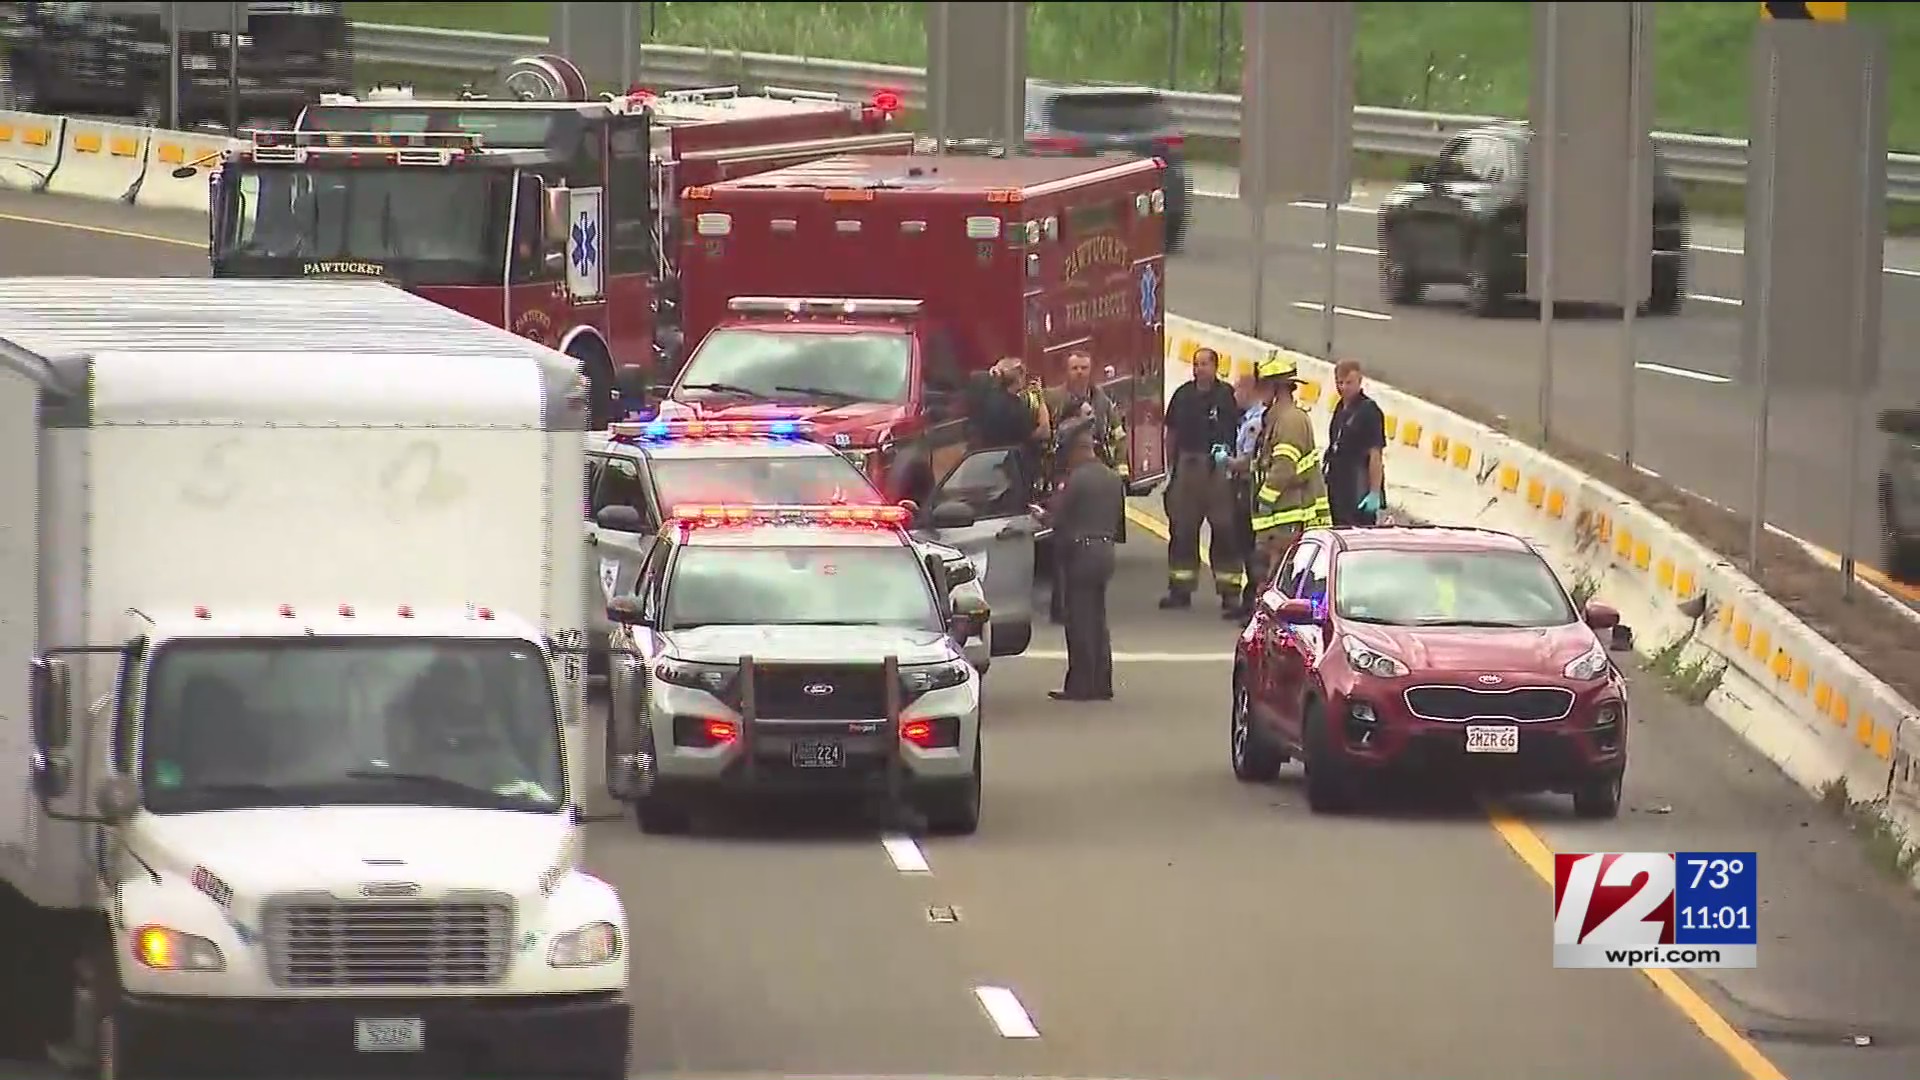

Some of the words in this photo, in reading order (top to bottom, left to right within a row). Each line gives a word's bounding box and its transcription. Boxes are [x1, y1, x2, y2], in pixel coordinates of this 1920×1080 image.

[303, 262, 383, 275] PAWTUCKET
[1500, 733, 1515, 747] 66
[817, 746, 838, 760] 224
